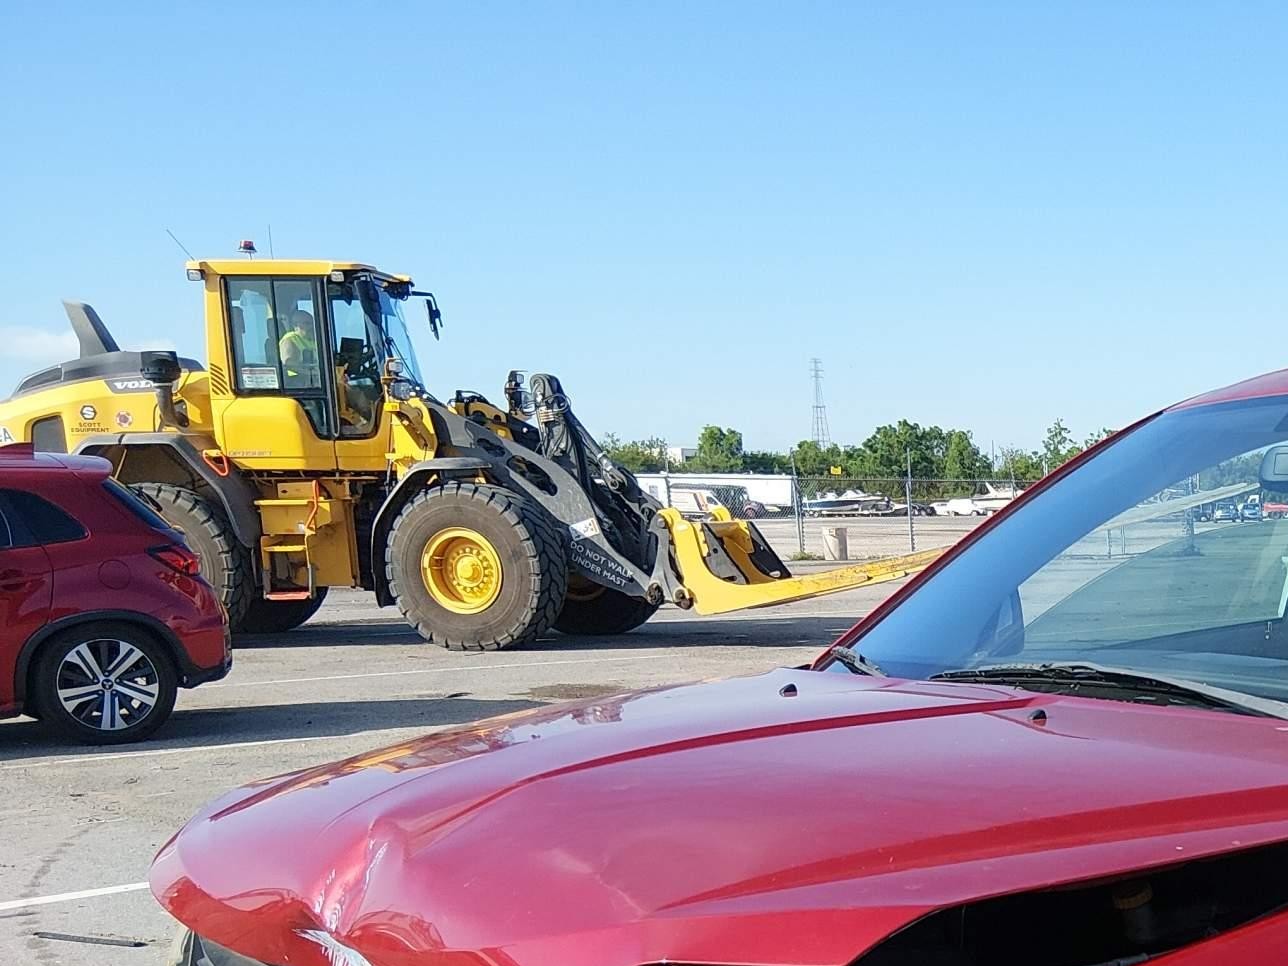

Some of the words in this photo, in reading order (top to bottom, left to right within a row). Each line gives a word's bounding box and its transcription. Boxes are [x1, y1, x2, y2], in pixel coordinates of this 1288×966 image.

[113, 380, 154, 389] VOL
[570, 541, 584, 553] DO
[585, 549, 606, 564] NOT
[608, 560, 633, 578] WALK
[571, 553, 601, 574] UNDER
[603, 570, 626, 586] MAST
